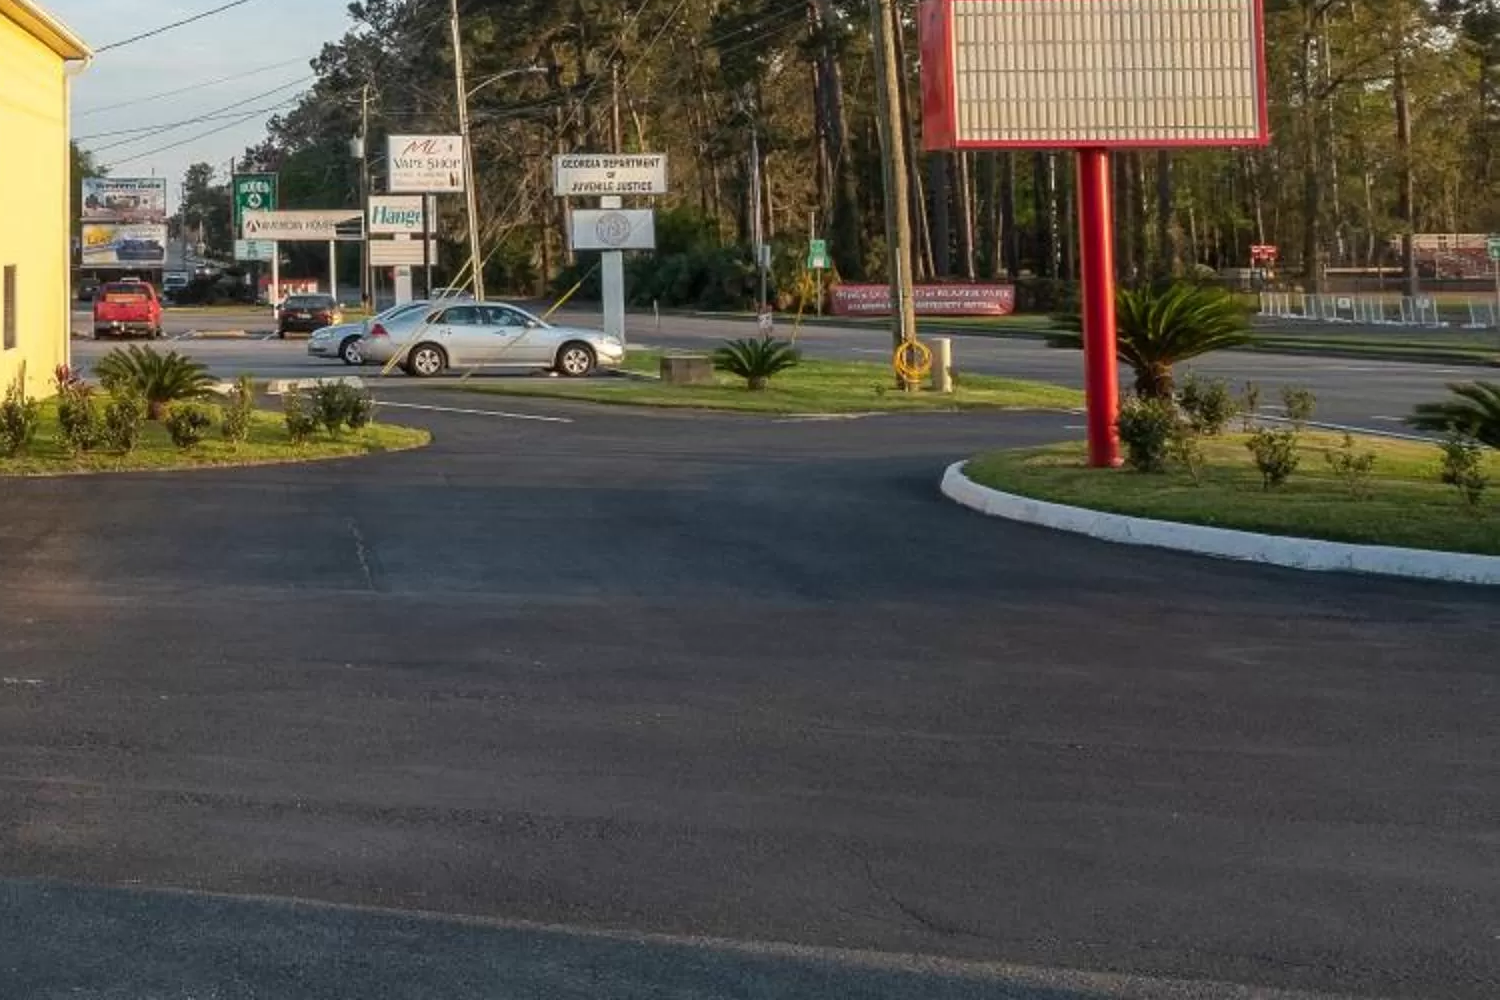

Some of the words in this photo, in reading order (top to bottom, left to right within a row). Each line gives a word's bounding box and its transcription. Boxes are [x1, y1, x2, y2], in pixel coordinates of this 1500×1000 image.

[393, 158, 422, 169] VAPE
[427, 158, 461, 170] SHOP
[561, 158, 601, 169] GEORGIA
[603, 158, 661, 169] DEPARTMENT
[606, 171, 616, 179] OF
[571, 182, 614, 191] JUVENILE
[616, 182, 653, 191] JUSTICE
